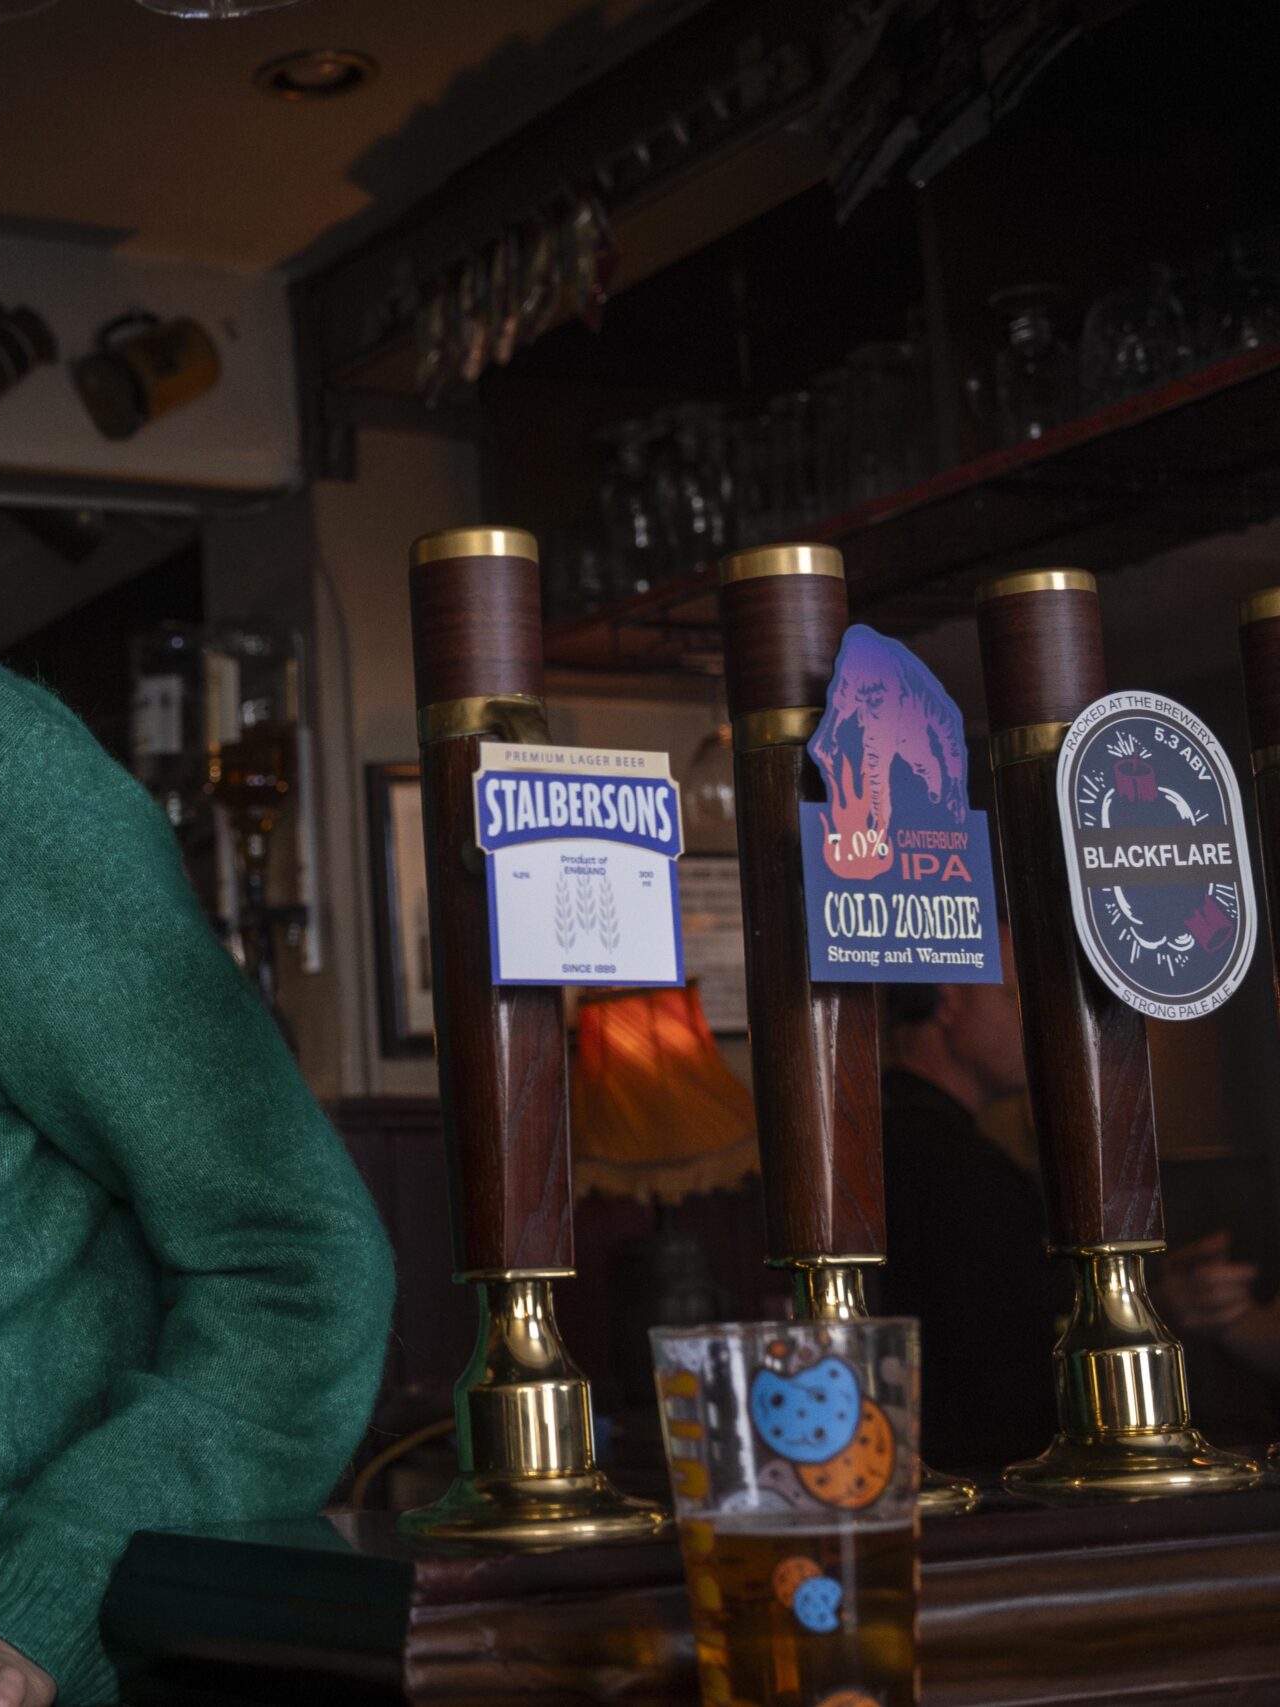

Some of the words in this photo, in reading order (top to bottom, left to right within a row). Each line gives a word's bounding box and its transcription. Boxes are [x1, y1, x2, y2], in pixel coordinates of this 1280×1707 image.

[1066, 704, 1107, 751] RACKED
[1109, 697, 1123, 711] AT
[1125, 696, 1152, 709] THE
[1154, 699, 1216, 747] BREWERY
[505, 750, 565, 764] PREMIUM
[570, 754, 610, 767] LAGER
[615, 756, 646, 768] BEER
[1154, 726, 1180, 750] 5.3
[1179, 746, 1212, 781] ABV
[485, 778, 673, 843] STALBERSONS
[828, 828, 889, 862] 7.0%
[897, 829, 968, 850] CANTERBURY
[560, 854, 598, 864] Product
[599, 856, 608, 865] of
[901, 852, 973, 882] IPA
[1083, 843, 1232, 869] BLACKFLARE
[564, 865, 607, 876] ENGLAND
[824, 891, 888, 938] COLD
[892, 894, 983, 939] ZOMBIE
[561, 963, 592, 974] SINCE
[827, 945, 880, 967] Strong
[884, 947, 913, 964] and
[916, 947, 985, 968] Warming
[1122, 989, 1177, 1019] STRONG
[1179, 1003, 1210, 1019] PALE
[1211, 983, 1233, 1008] ALE
